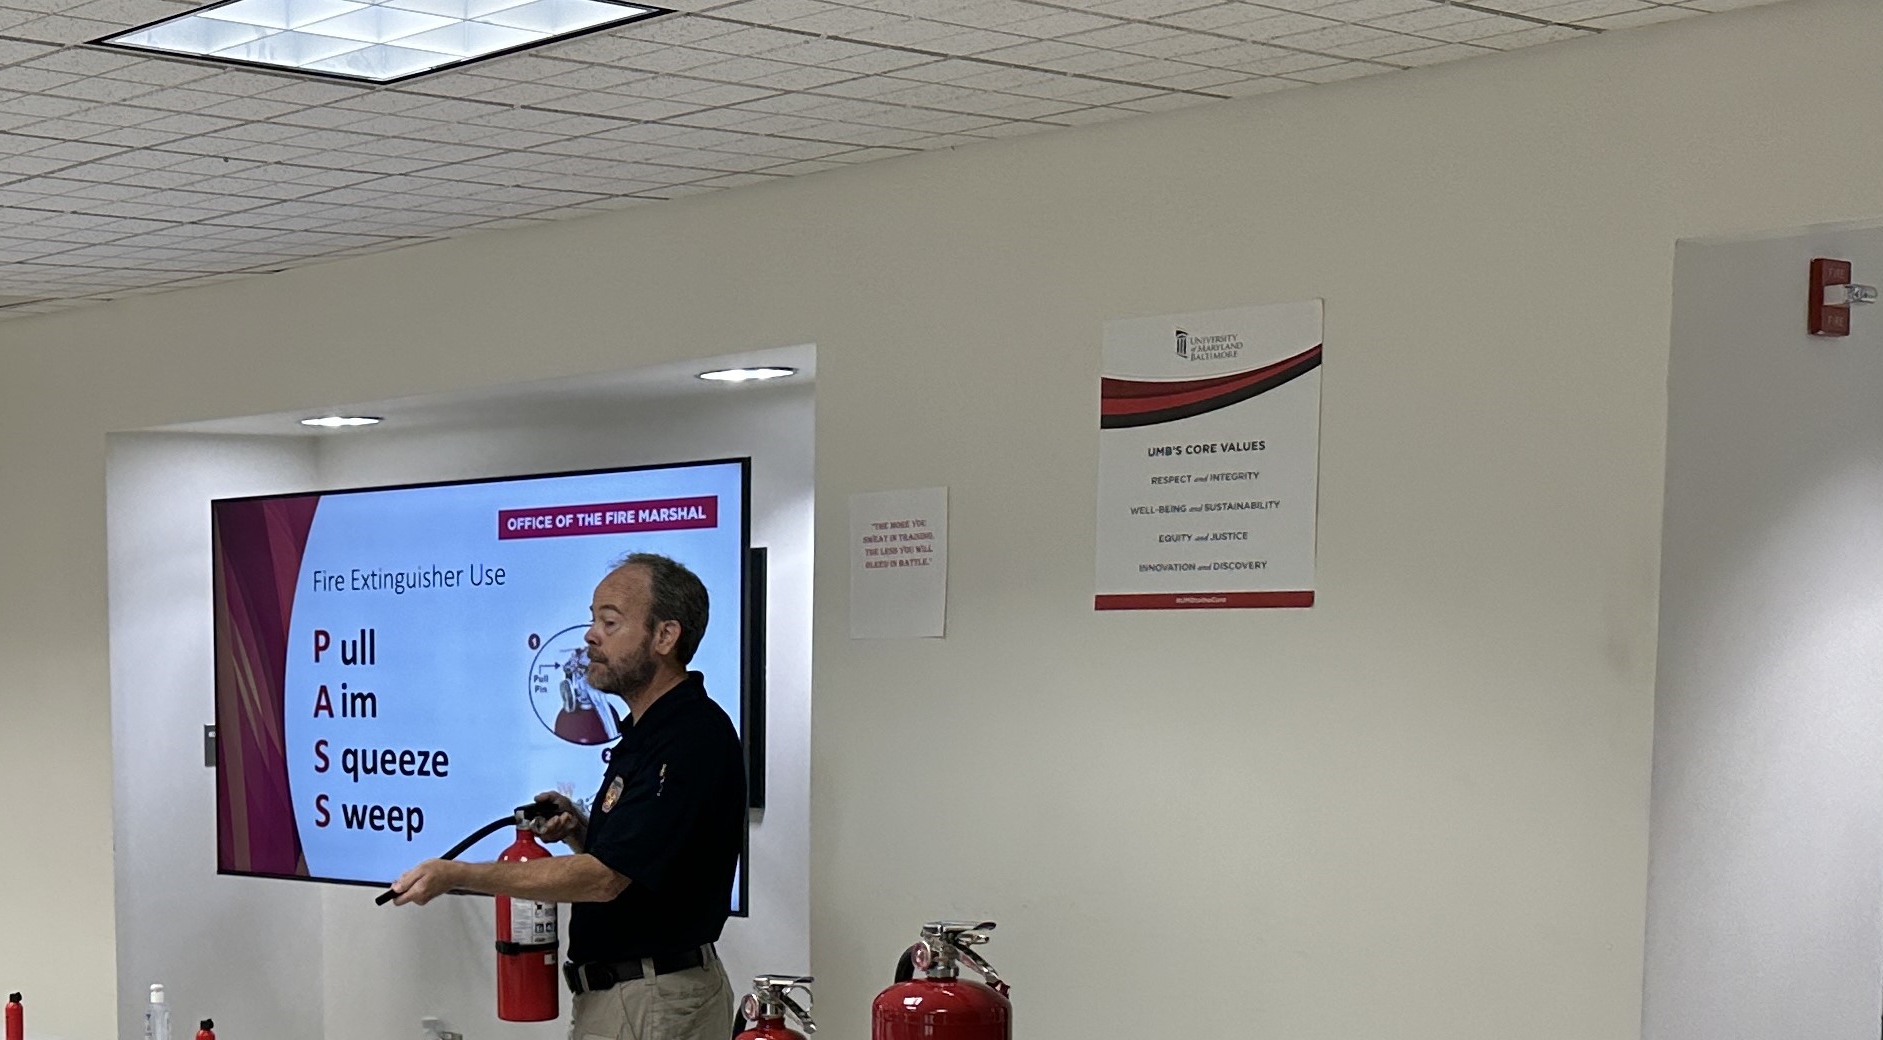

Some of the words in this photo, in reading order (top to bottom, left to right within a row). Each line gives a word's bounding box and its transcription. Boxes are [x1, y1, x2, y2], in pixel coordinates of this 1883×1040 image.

[1190, 334, 1237, 345] UNIVERSITY
[1198, 342, 1244, 352] MARYLAND
[1190, 351, 1238, 361] BALTIMORE
[1148, 446, 1182, 457] UMB'S
[1185, 444, 1218, 455] CORE
[1220, 440, 1266, 453] VALUES
[1151, 475, 1192, 485] RESPECT
[1210, 471, 1260, 482] INTEGRITY
[1130, 504, 1187, 515] WELL-BEING
[1204, 500, 1281, 512] SUSTAINABILITY
[507, 515, 553, 531] OFFICE
[555, 514, 573, 528] OF
[576, 512, 602, 526] THE
[605, 510, 635, 524] FIRE
[638, 505, 707, 523] MARSHAL
[1158, 534, 1193, 543] EQUITY
[1210, 531, 1249, 541] JUSTICE
[1139, 563, 1196, 572] INNOVATION
[1212, 560, 1268, 571] DISCOVERY
[313, 570, 345, 592] Fire
[351, 564, 464, 595] Extinguisher
[470, 563, 506, 586] Use
[314, 630, 331, 663] P
[341, 628, 375, 665] ull
[534, 675, 548, 683] Pull
[314, 685, 334, 718] A
[341, 682, 377, 718] im
[314, 739, 330, 773] S
[341, 748, 449, 783] queeze
[315, 794, 331, 828] S
[342, 803, 424, 842] weep
